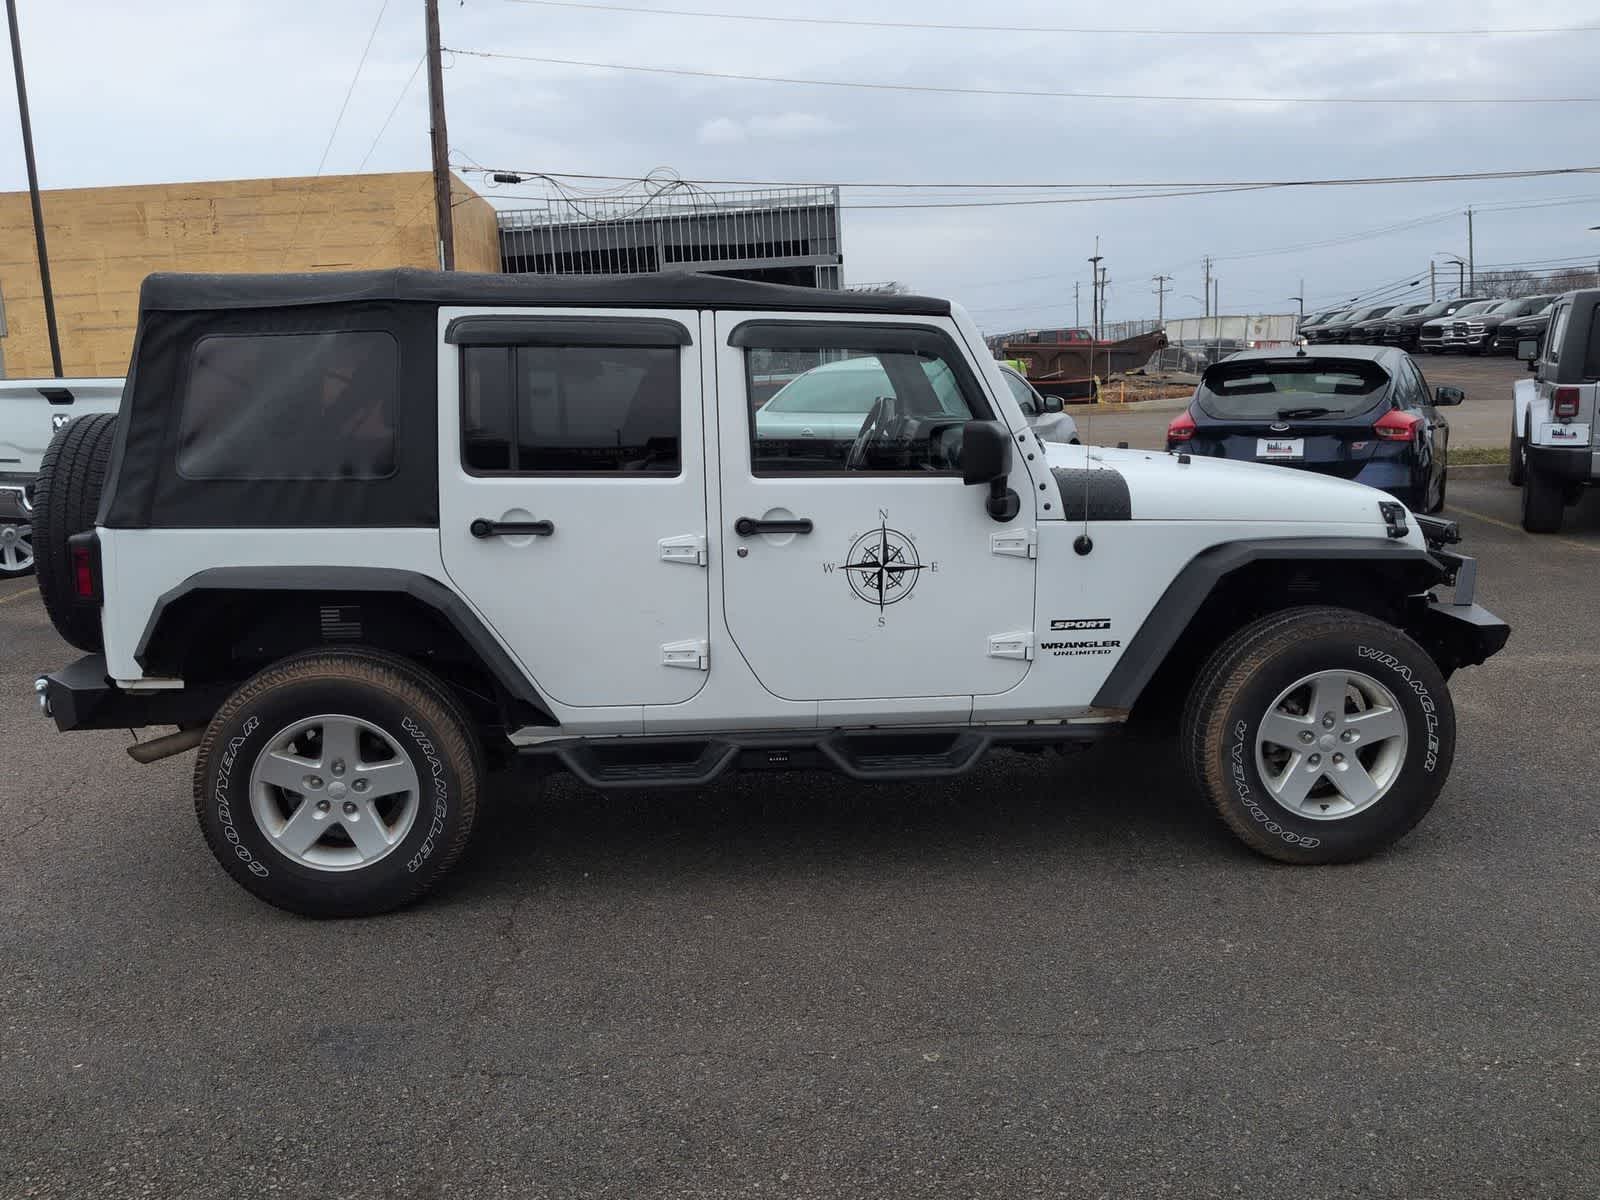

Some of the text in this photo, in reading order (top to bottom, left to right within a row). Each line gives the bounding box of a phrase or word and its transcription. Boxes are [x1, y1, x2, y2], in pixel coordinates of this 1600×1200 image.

[879, 508, 888, 520] N
[823, 562, 835, 574] W
[931, 562, 940, 573] E
[877, 616, 886, 628] S
[1051, 619, 1110, 630] SPORT
[1041, 640, 1121, 649] WRANGLER
[1358, 645, 1440, 773] WRANGLER
[1231, 719, 1321, 848] GOODYEAR
[215, 715, 270, 878] GOODYEAR
[401, 716, 448, 873] WRANGLER
